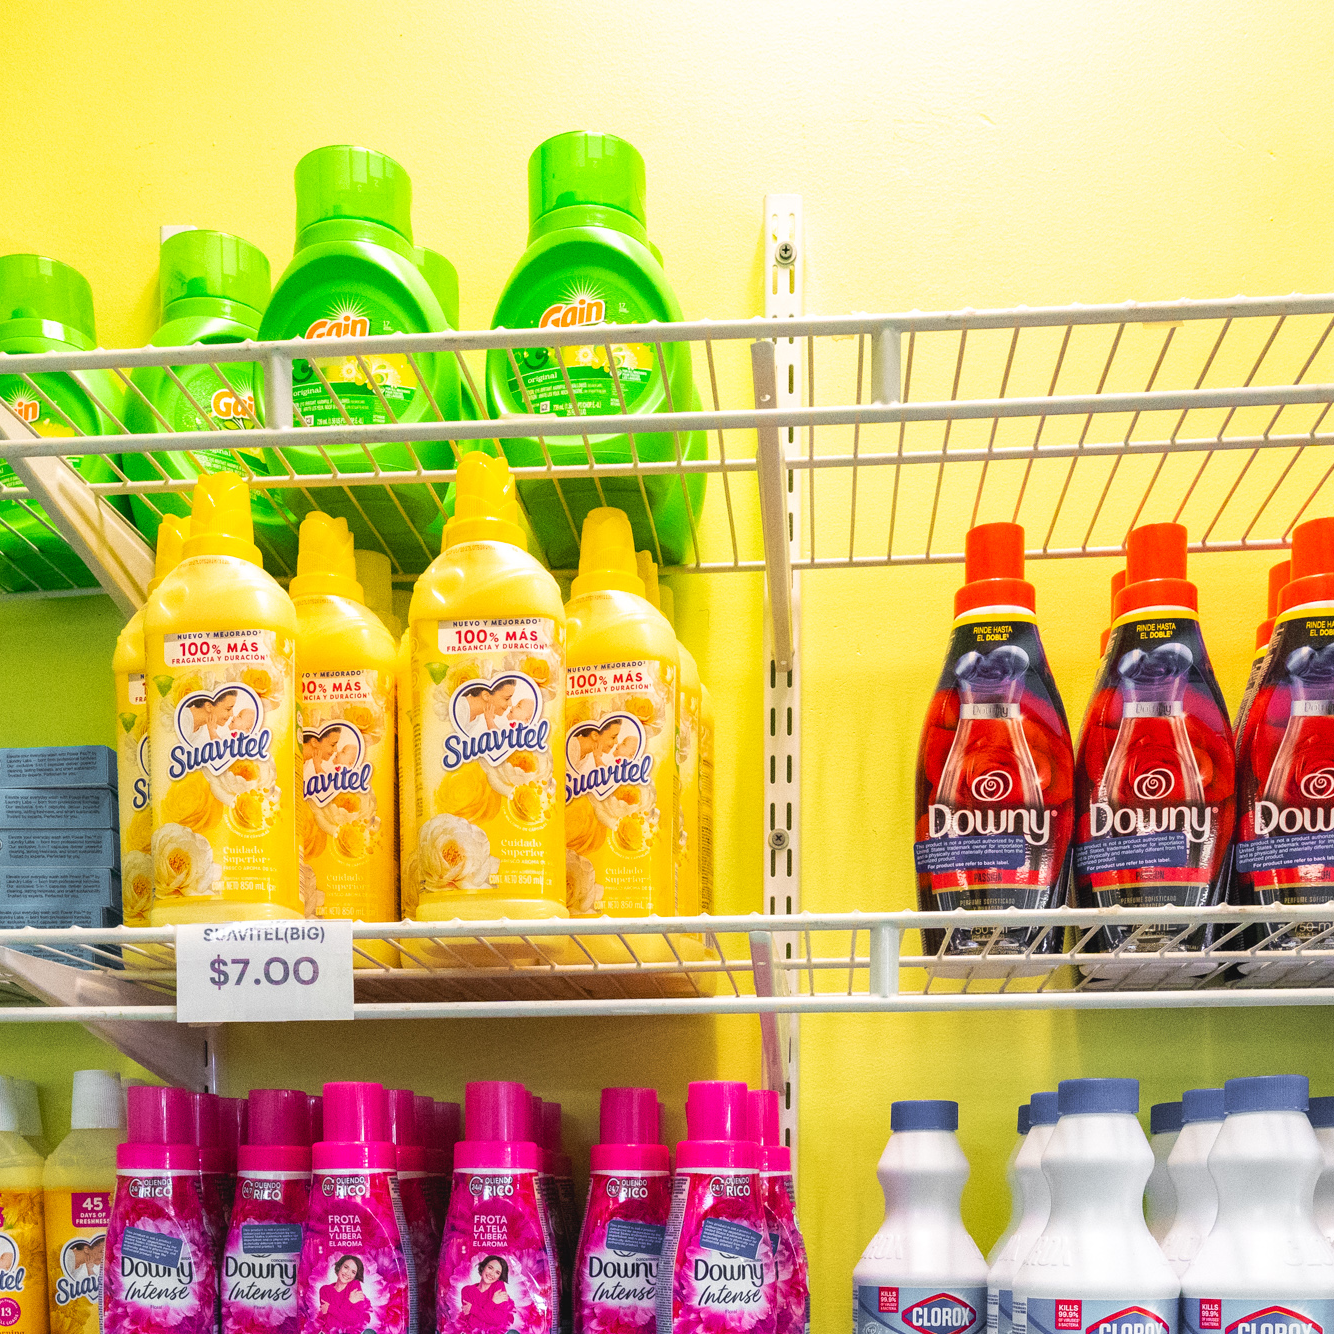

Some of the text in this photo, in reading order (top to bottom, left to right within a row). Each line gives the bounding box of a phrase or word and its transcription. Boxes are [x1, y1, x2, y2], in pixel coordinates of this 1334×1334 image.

[540, 299, 603, 327] Gain
[456, 629, 537, 644] 100% MÁS
[180, 640, 258, 656] 100% MÁS
[170, 729, 269, 778] Suavitel
[443, 720, 548, 769] Suavitel
[567, 754, 653, 805] Suavitel
[929, 804, 1050, 845] Downy
[240, 881, 253, 891] 850
[210, 955, 319, 990] $7.00
[727, 1176, 749, 1184] OLIENDO
[726, 1185, 750, 1198] RICO
[328, 1215, 360, 1224] FROTA
[329, 1224, 360, 1233] LA TELA
[328, 1232, 361, 1240] Y LIBERA
[226, 1257, 296, 1286] Downy
[694, 1257, 764, 1285] Downy
[229, 1283, 292, 1302] Intense
[699, 1285, 761, 1305] Intense
